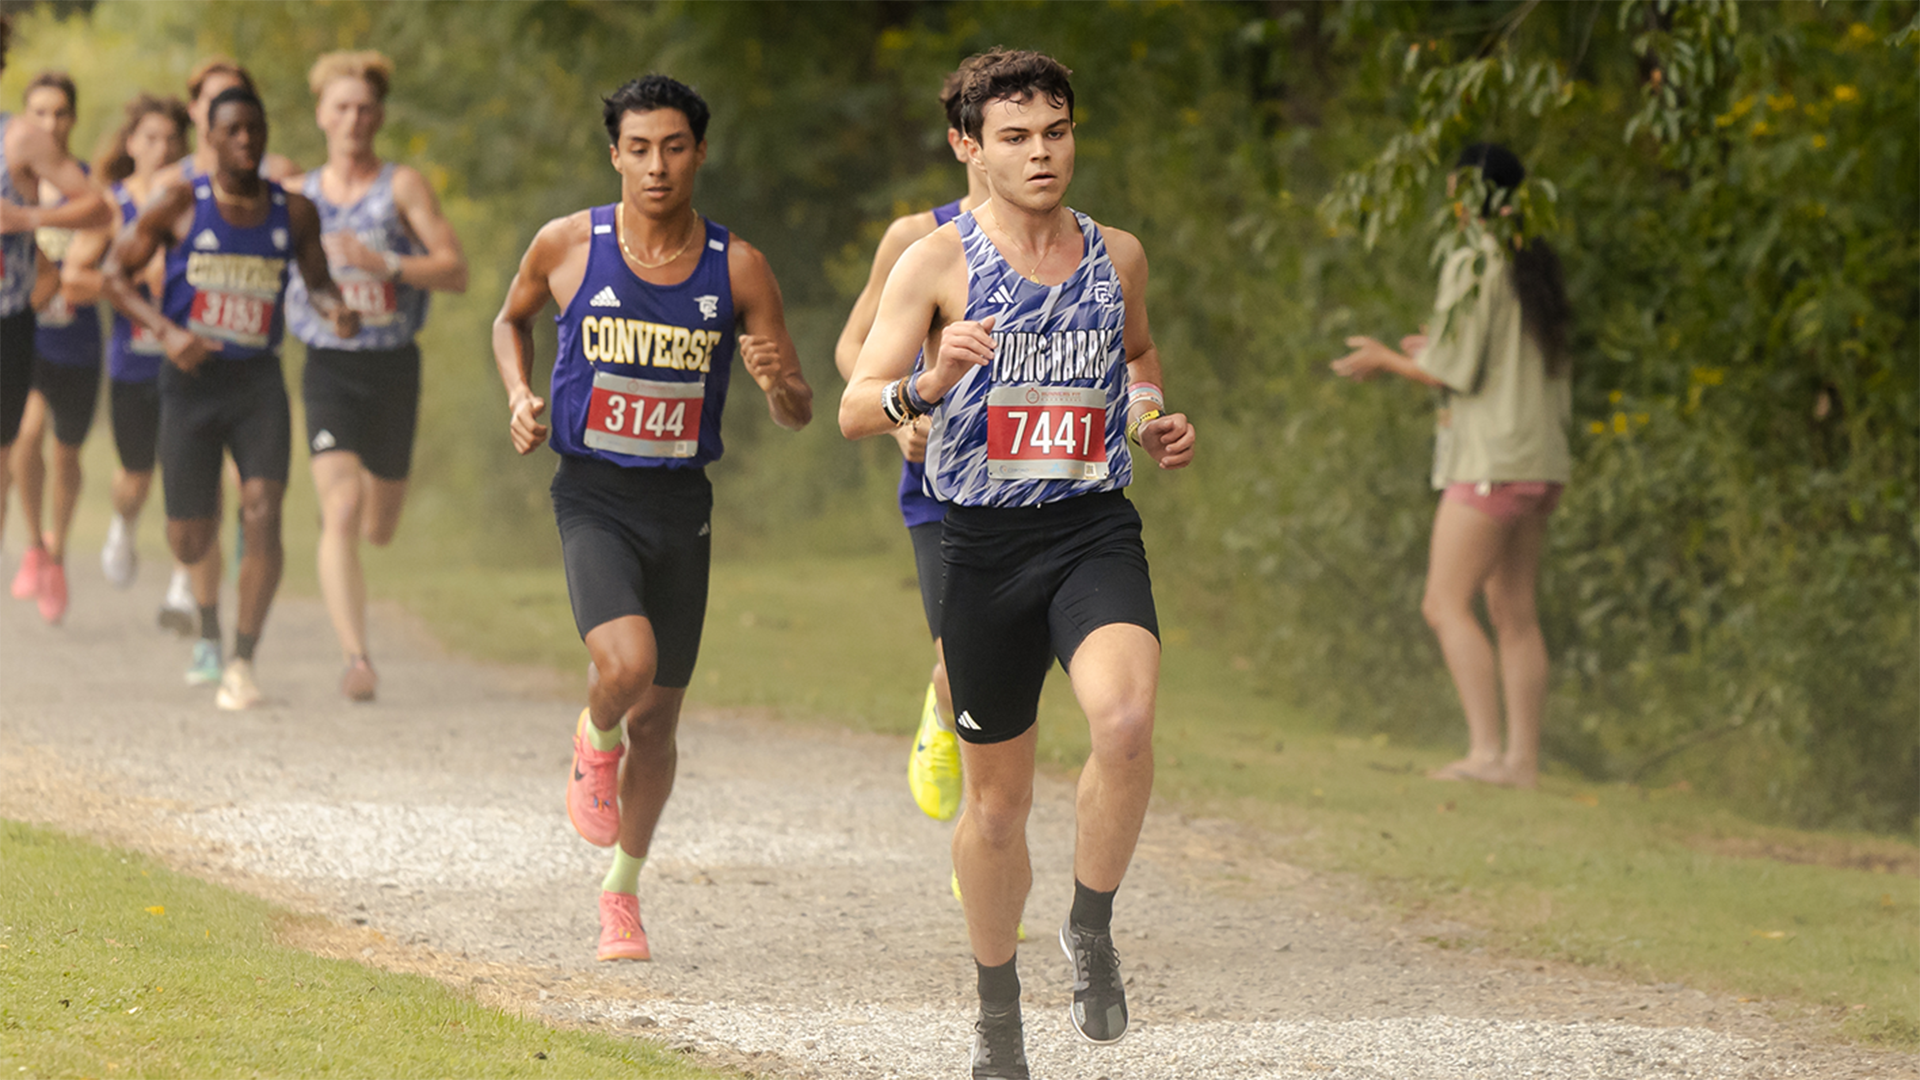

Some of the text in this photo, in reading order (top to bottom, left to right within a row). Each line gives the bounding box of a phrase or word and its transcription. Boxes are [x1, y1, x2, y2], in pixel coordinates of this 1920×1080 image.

[582, 315, 722, 373] CONVERSE
[991, 330, 1047, 383] YOUNG
[604, 394, 686, 437] 3144
[1007, 411, 1092, 456] 7441
